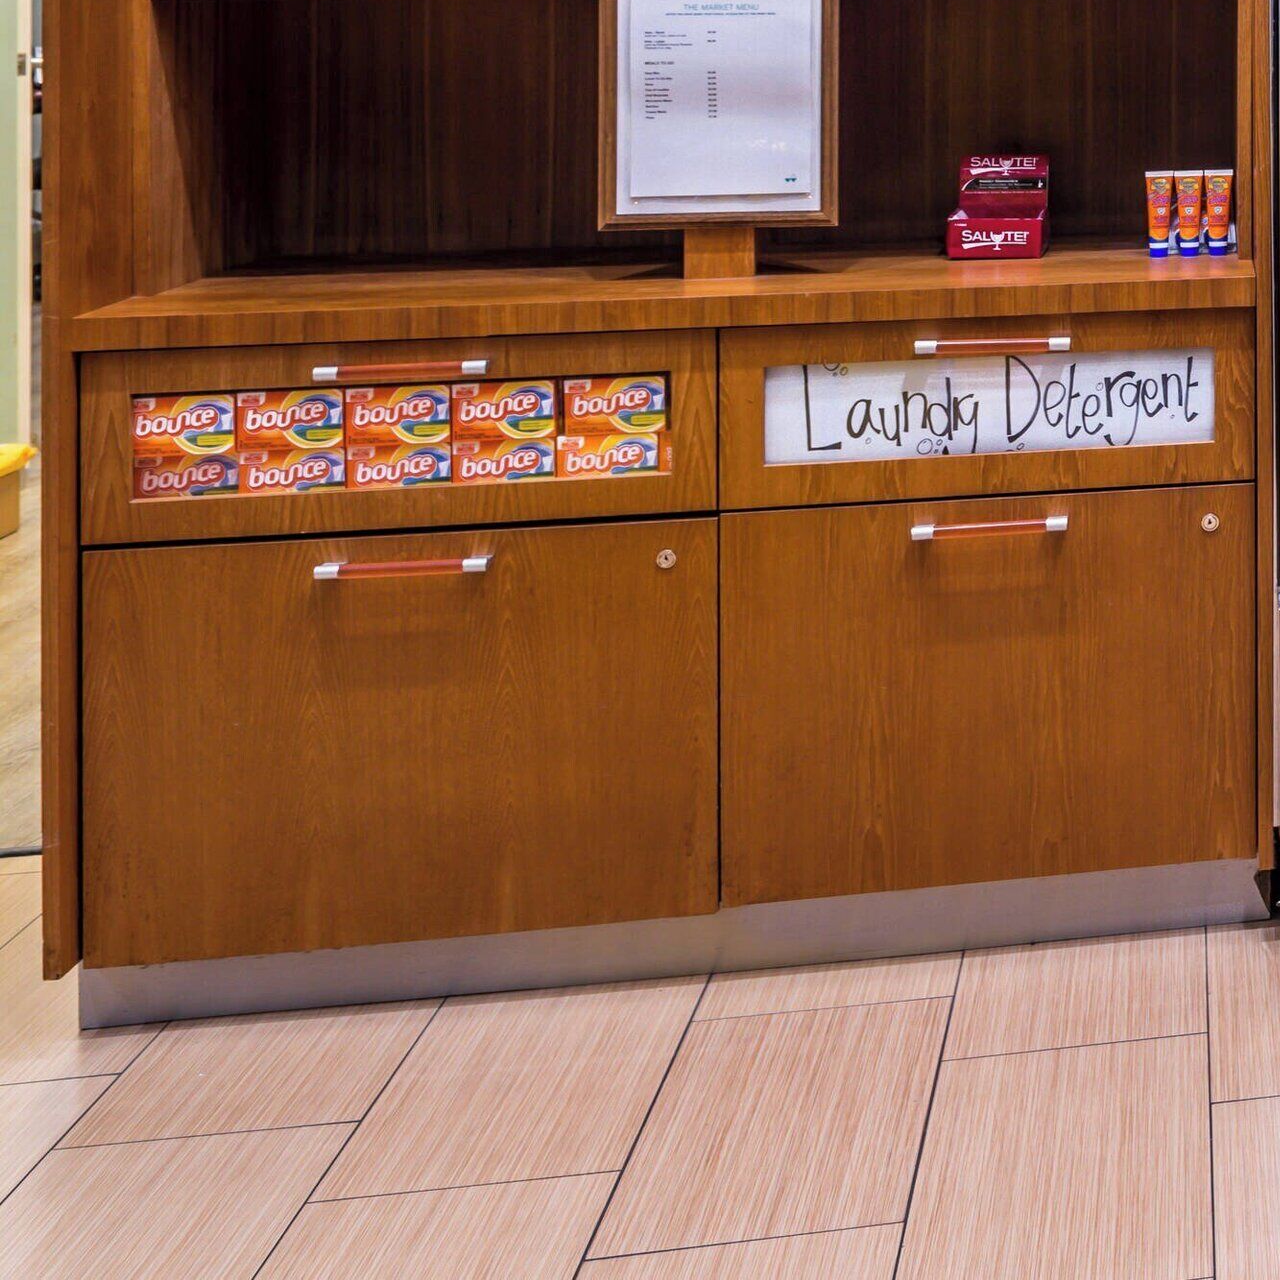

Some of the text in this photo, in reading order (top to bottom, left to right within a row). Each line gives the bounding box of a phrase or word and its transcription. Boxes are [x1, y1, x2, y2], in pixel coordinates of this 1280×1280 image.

[683, 3, 760, 11] THE MARKET MENU
[970, 156, 1038, 169] SALUTE!
[961, 229, 1030, 243] SALUTE!
[245, 401, 330, 433] bounce
[353, 396, 439, 428] bounce
[461, 391, 545, 423] bounce
[572, 386, 654, 418] bounce
[801, 354, 1200, 455] Laundry Detergent
[135, 407, 219, 439] bounce
[248, 456, 333, 488] bounce
[355, 450, 441, 483] bounce
[461, 446, 544, 479] bounce
[568, 444, 650, 473] bounce
[141, 461, 224, 493] bounce
